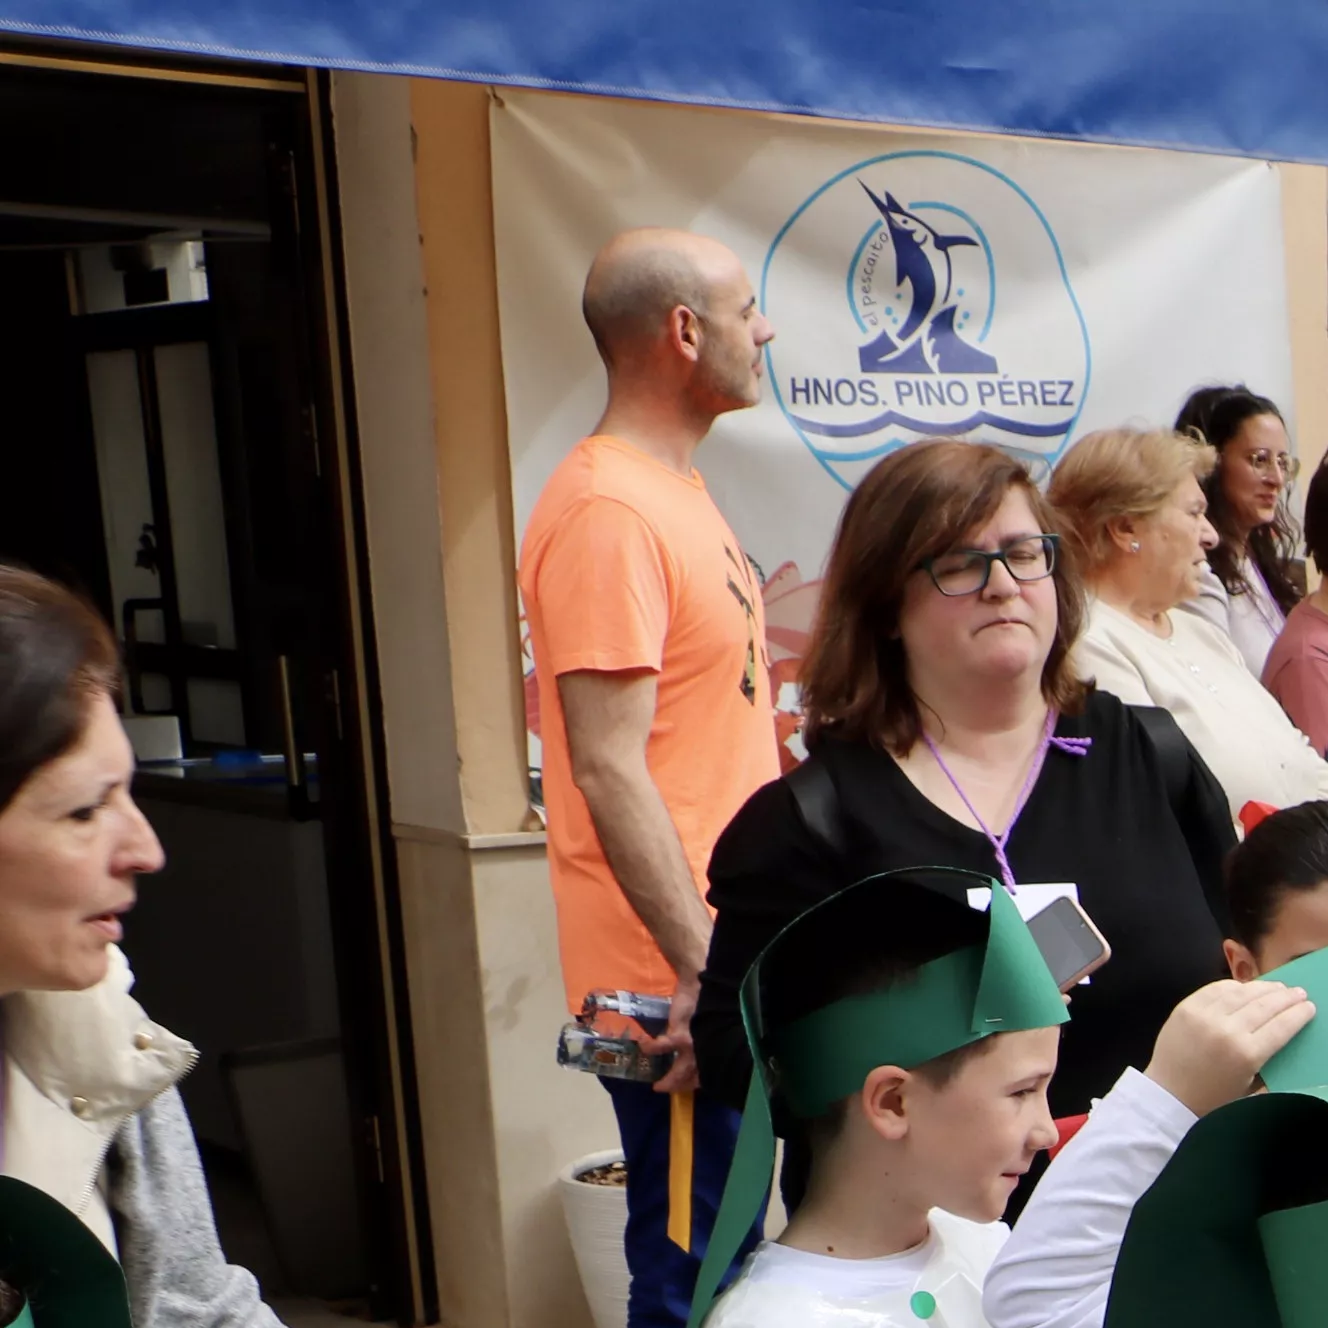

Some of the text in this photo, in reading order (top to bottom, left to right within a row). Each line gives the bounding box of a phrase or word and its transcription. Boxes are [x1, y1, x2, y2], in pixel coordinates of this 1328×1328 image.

[861, 231, 889, 307] pescaito
[790, 374, 1074, 406] HNOS. PINO PÉREZ
